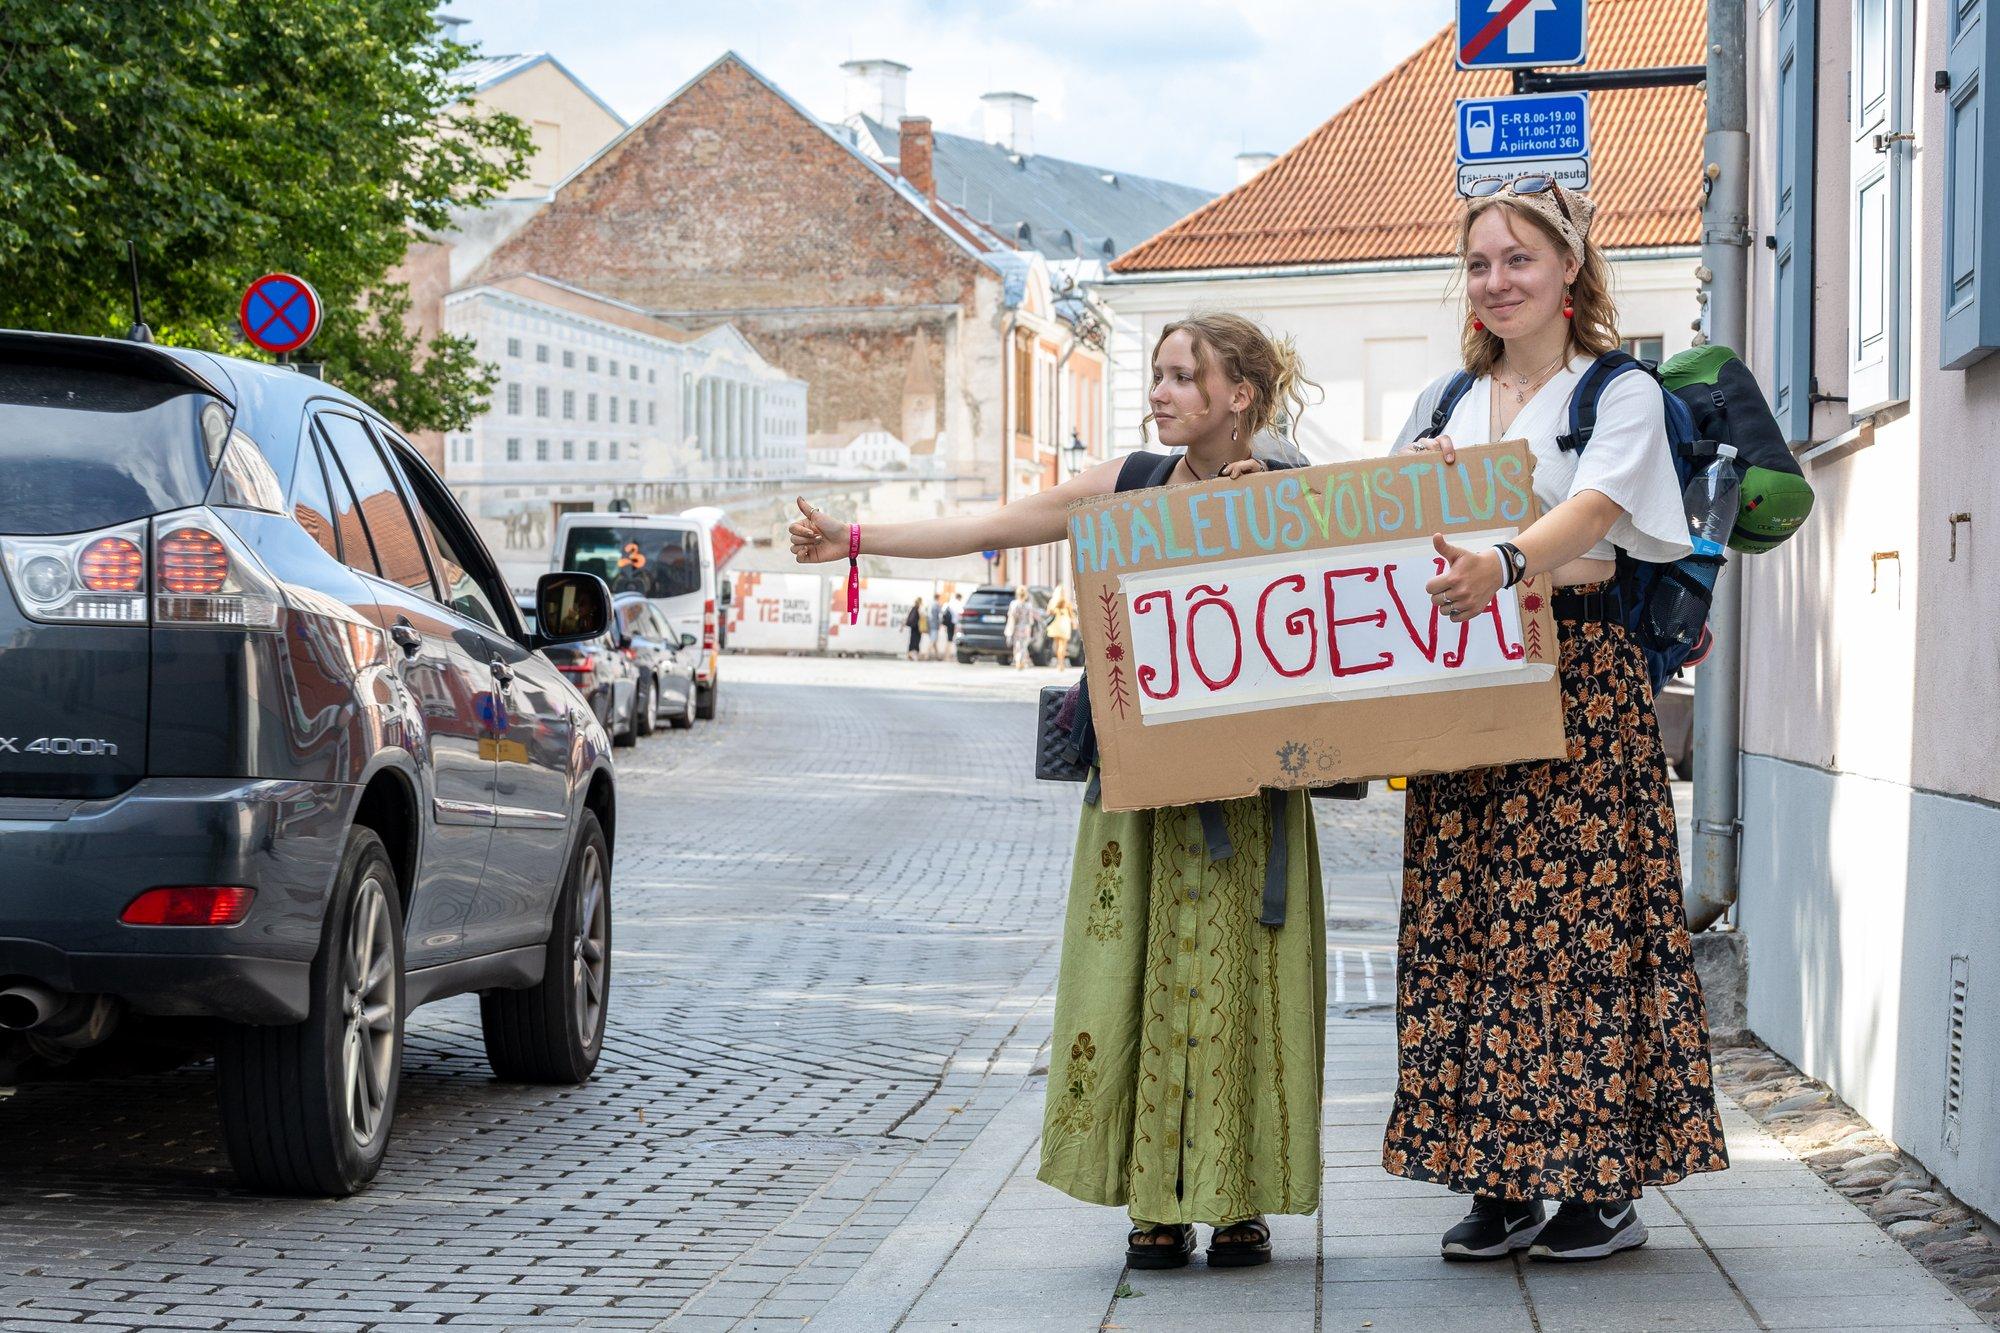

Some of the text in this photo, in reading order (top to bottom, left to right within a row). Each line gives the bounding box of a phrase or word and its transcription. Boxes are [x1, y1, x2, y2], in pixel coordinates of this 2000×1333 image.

[1501, 110, 1576, 125] E-R 8.00-19.00
[1501, 124, 1577, 138] L 11.00-17.00
[1500, 136, 1579, 154] A piirkond 3€h
[1554, 169, 1586, 180] tasuta
[783, 599, 809, 609] TARTU
[24, 737, 118, 755] 400h
